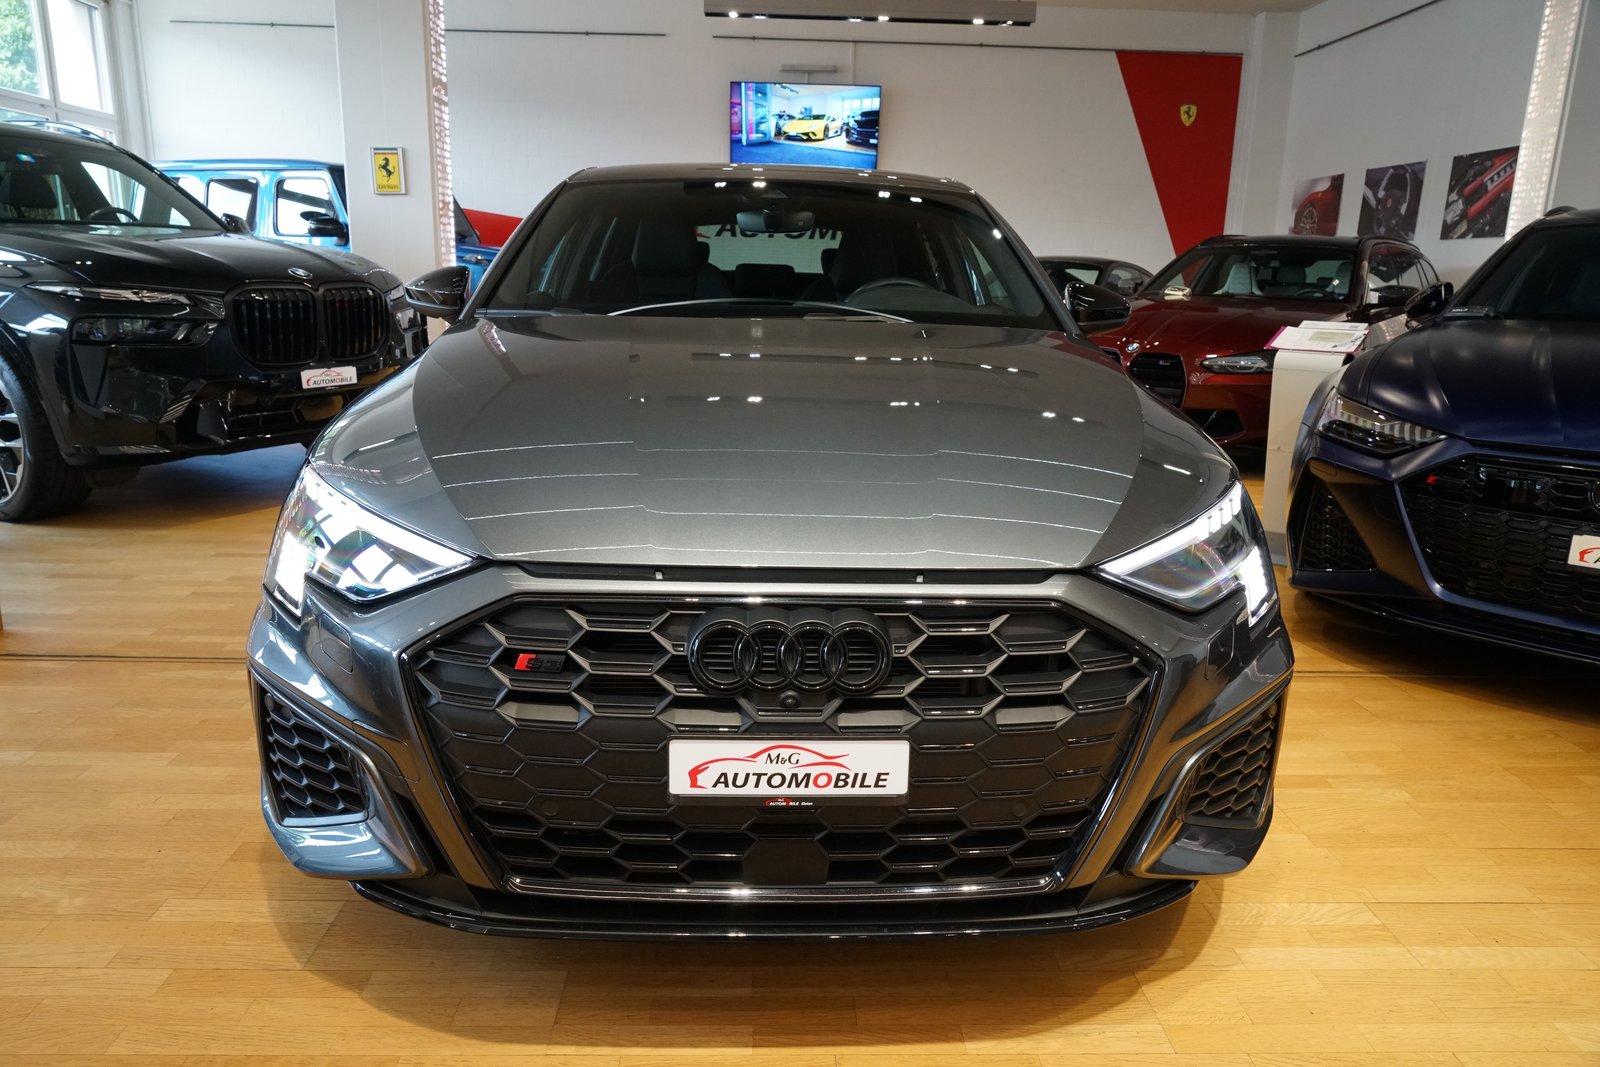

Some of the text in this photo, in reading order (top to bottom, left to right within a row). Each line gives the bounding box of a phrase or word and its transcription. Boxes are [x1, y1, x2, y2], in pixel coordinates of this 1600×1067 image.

[312, 376, 353, 386] AUTOMOBILE
[765, 752, 801, 765] M&G
[712, 772, 890, 789] AUTOMOBILE
